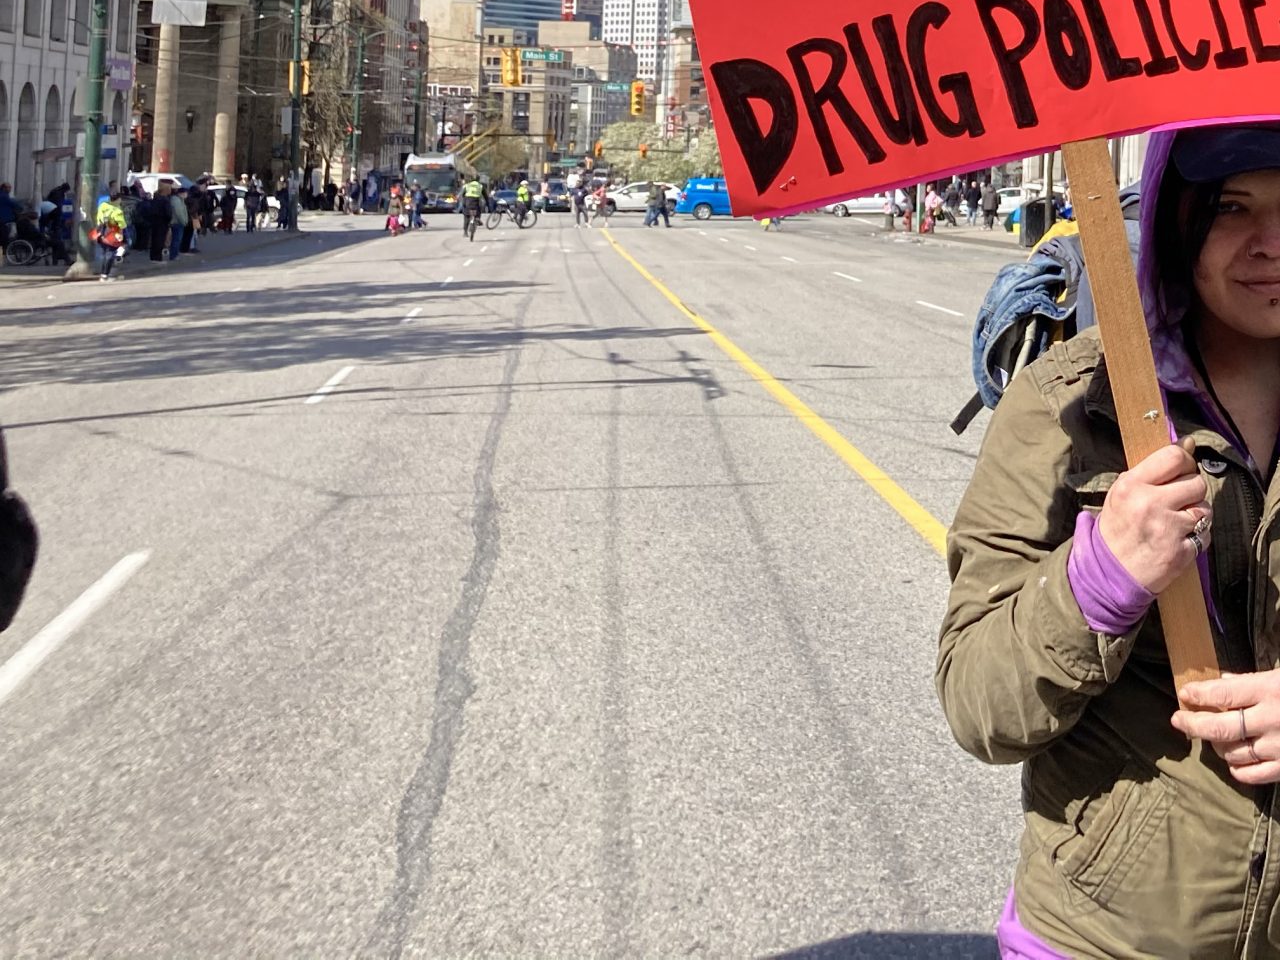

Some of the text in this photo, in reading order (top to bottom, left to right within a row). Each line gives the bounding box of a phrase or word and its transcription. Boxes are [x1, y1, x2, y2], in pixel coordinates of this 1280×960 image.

[525, 51, 559, 60] Main St
[711, 5, 984, 197] DRUG
